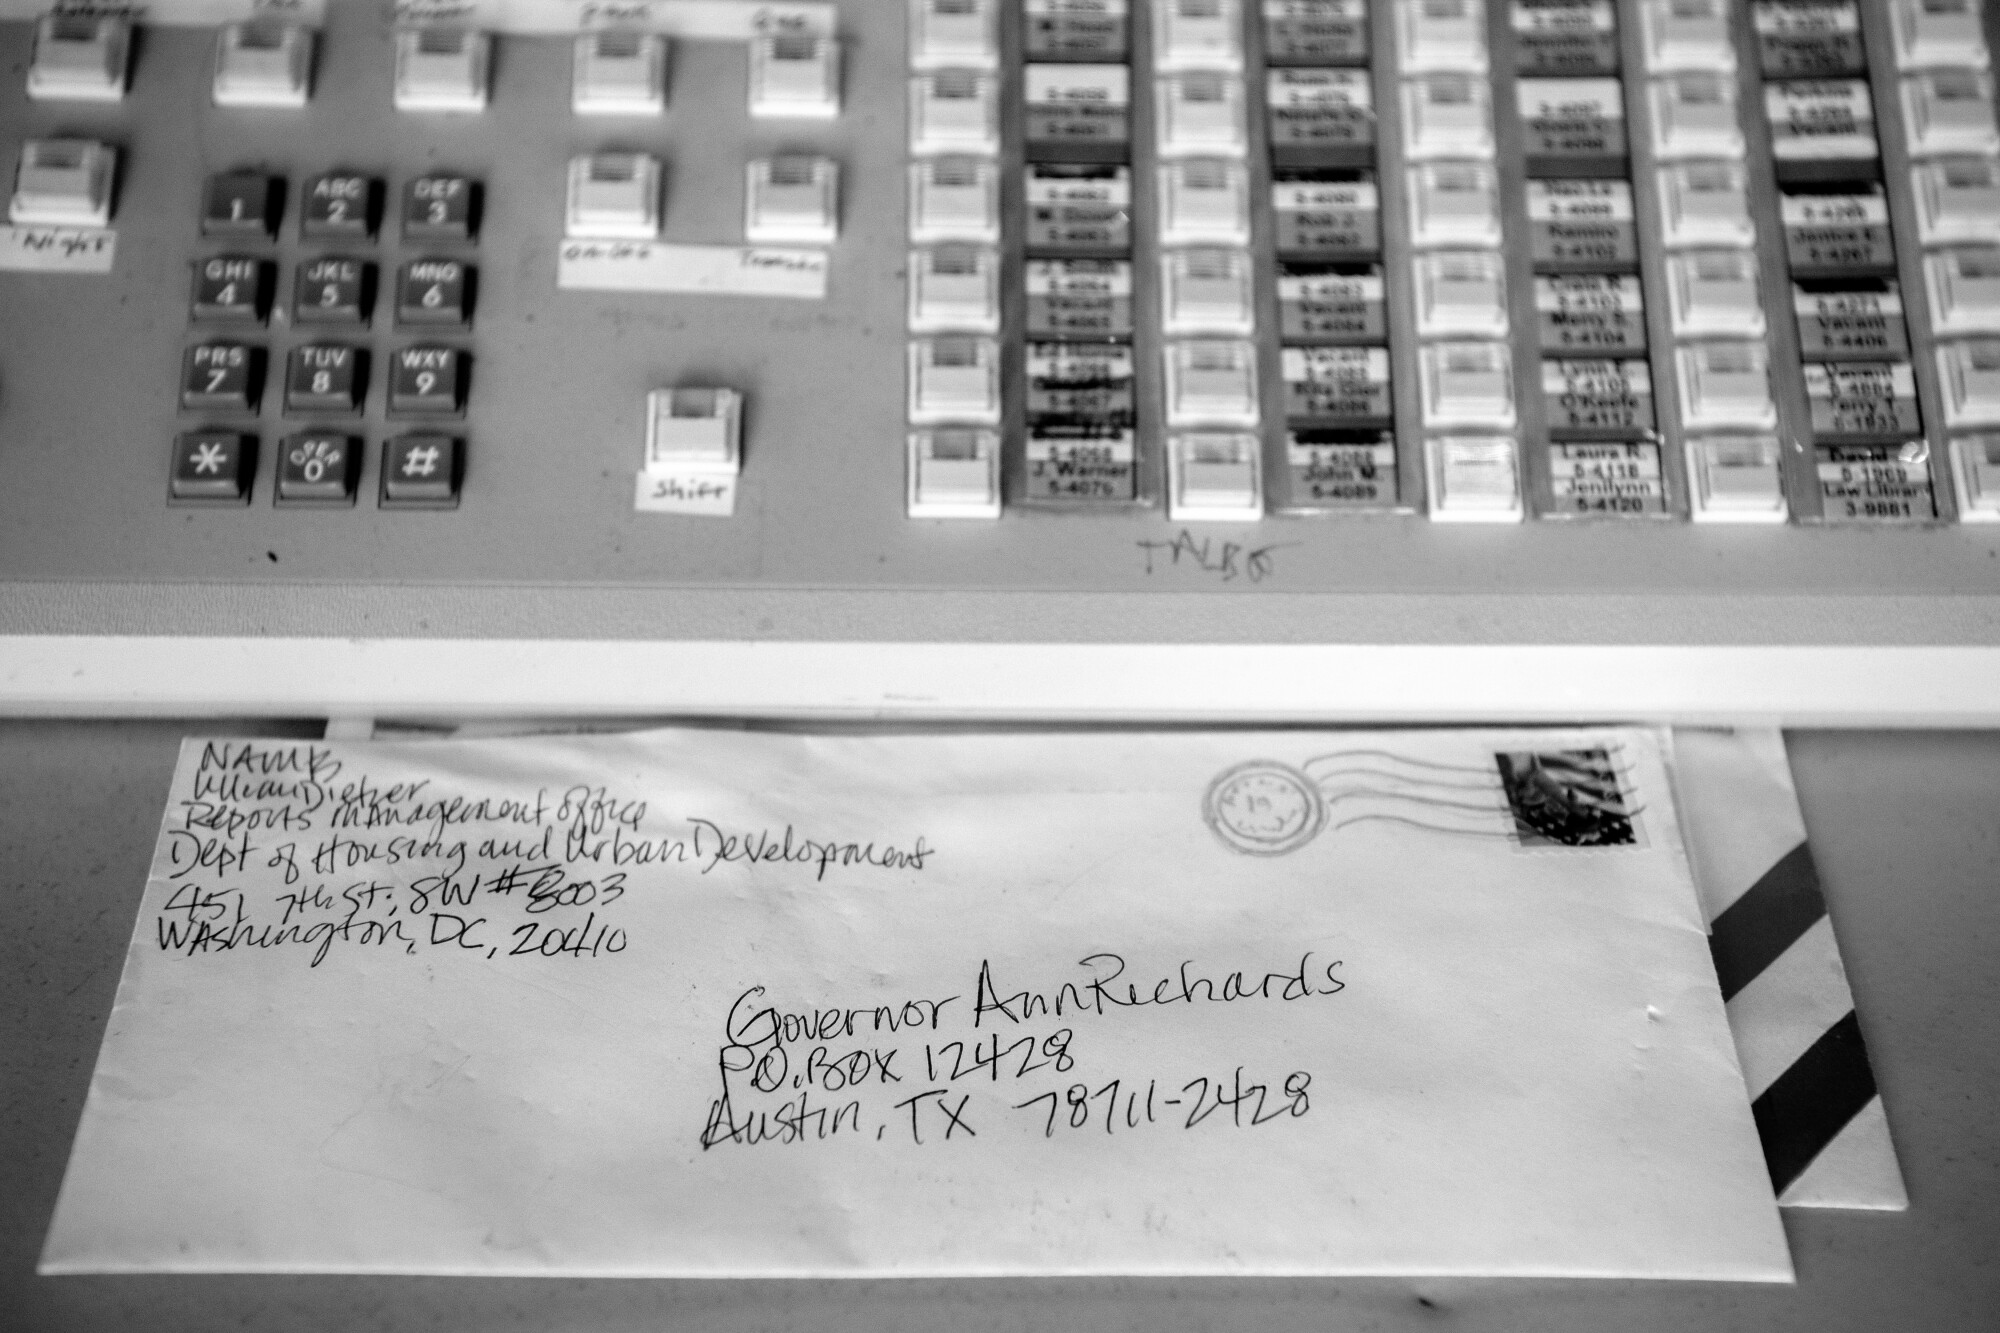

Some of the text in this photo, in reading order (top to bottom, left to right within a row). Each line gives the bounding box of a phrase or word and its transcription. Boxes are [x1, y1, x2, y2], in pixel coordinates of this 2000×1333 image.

[313, 177, 362, 198] ABC
[414, 178, 464, 198] DEF
[231, 198, 242, 221] 1
[327, 200, 347, 224] 2
[428, 200, 447, 225] 3
[206, 259, 252, 281] GHI
[307, 261, 354, 282] JKL
[409, 262, 459, 282] MNO
[216, 283, 236, 305] 4
[320, 284, 338, 308] 5
[422, 284, 441, 308] 6
[302, 346, 347, 367] TUV
[402, 348, 449, 369] WXY
[206, 368, 227, 392] 7
[311, 370, 331, 393] 8
[416, 370, 435, 394] 9
[402, 446, 440, 476] #
[651, 478, 728, 501] Shift
[267, 842, 301, 885] of
[477, 824, 554, 862] and
[164, 884, 245, 924] 451
[508, 911, 628, 959] 20410
[726, 985, 962, 1049] Governor
[972, 958, 1086, 1028] Ann
[925, 1028, 1075, 1082] 12428
[893, 1089, 977, 1145] TX
[1011, 1065, 1313, 1138] 78711-2428
